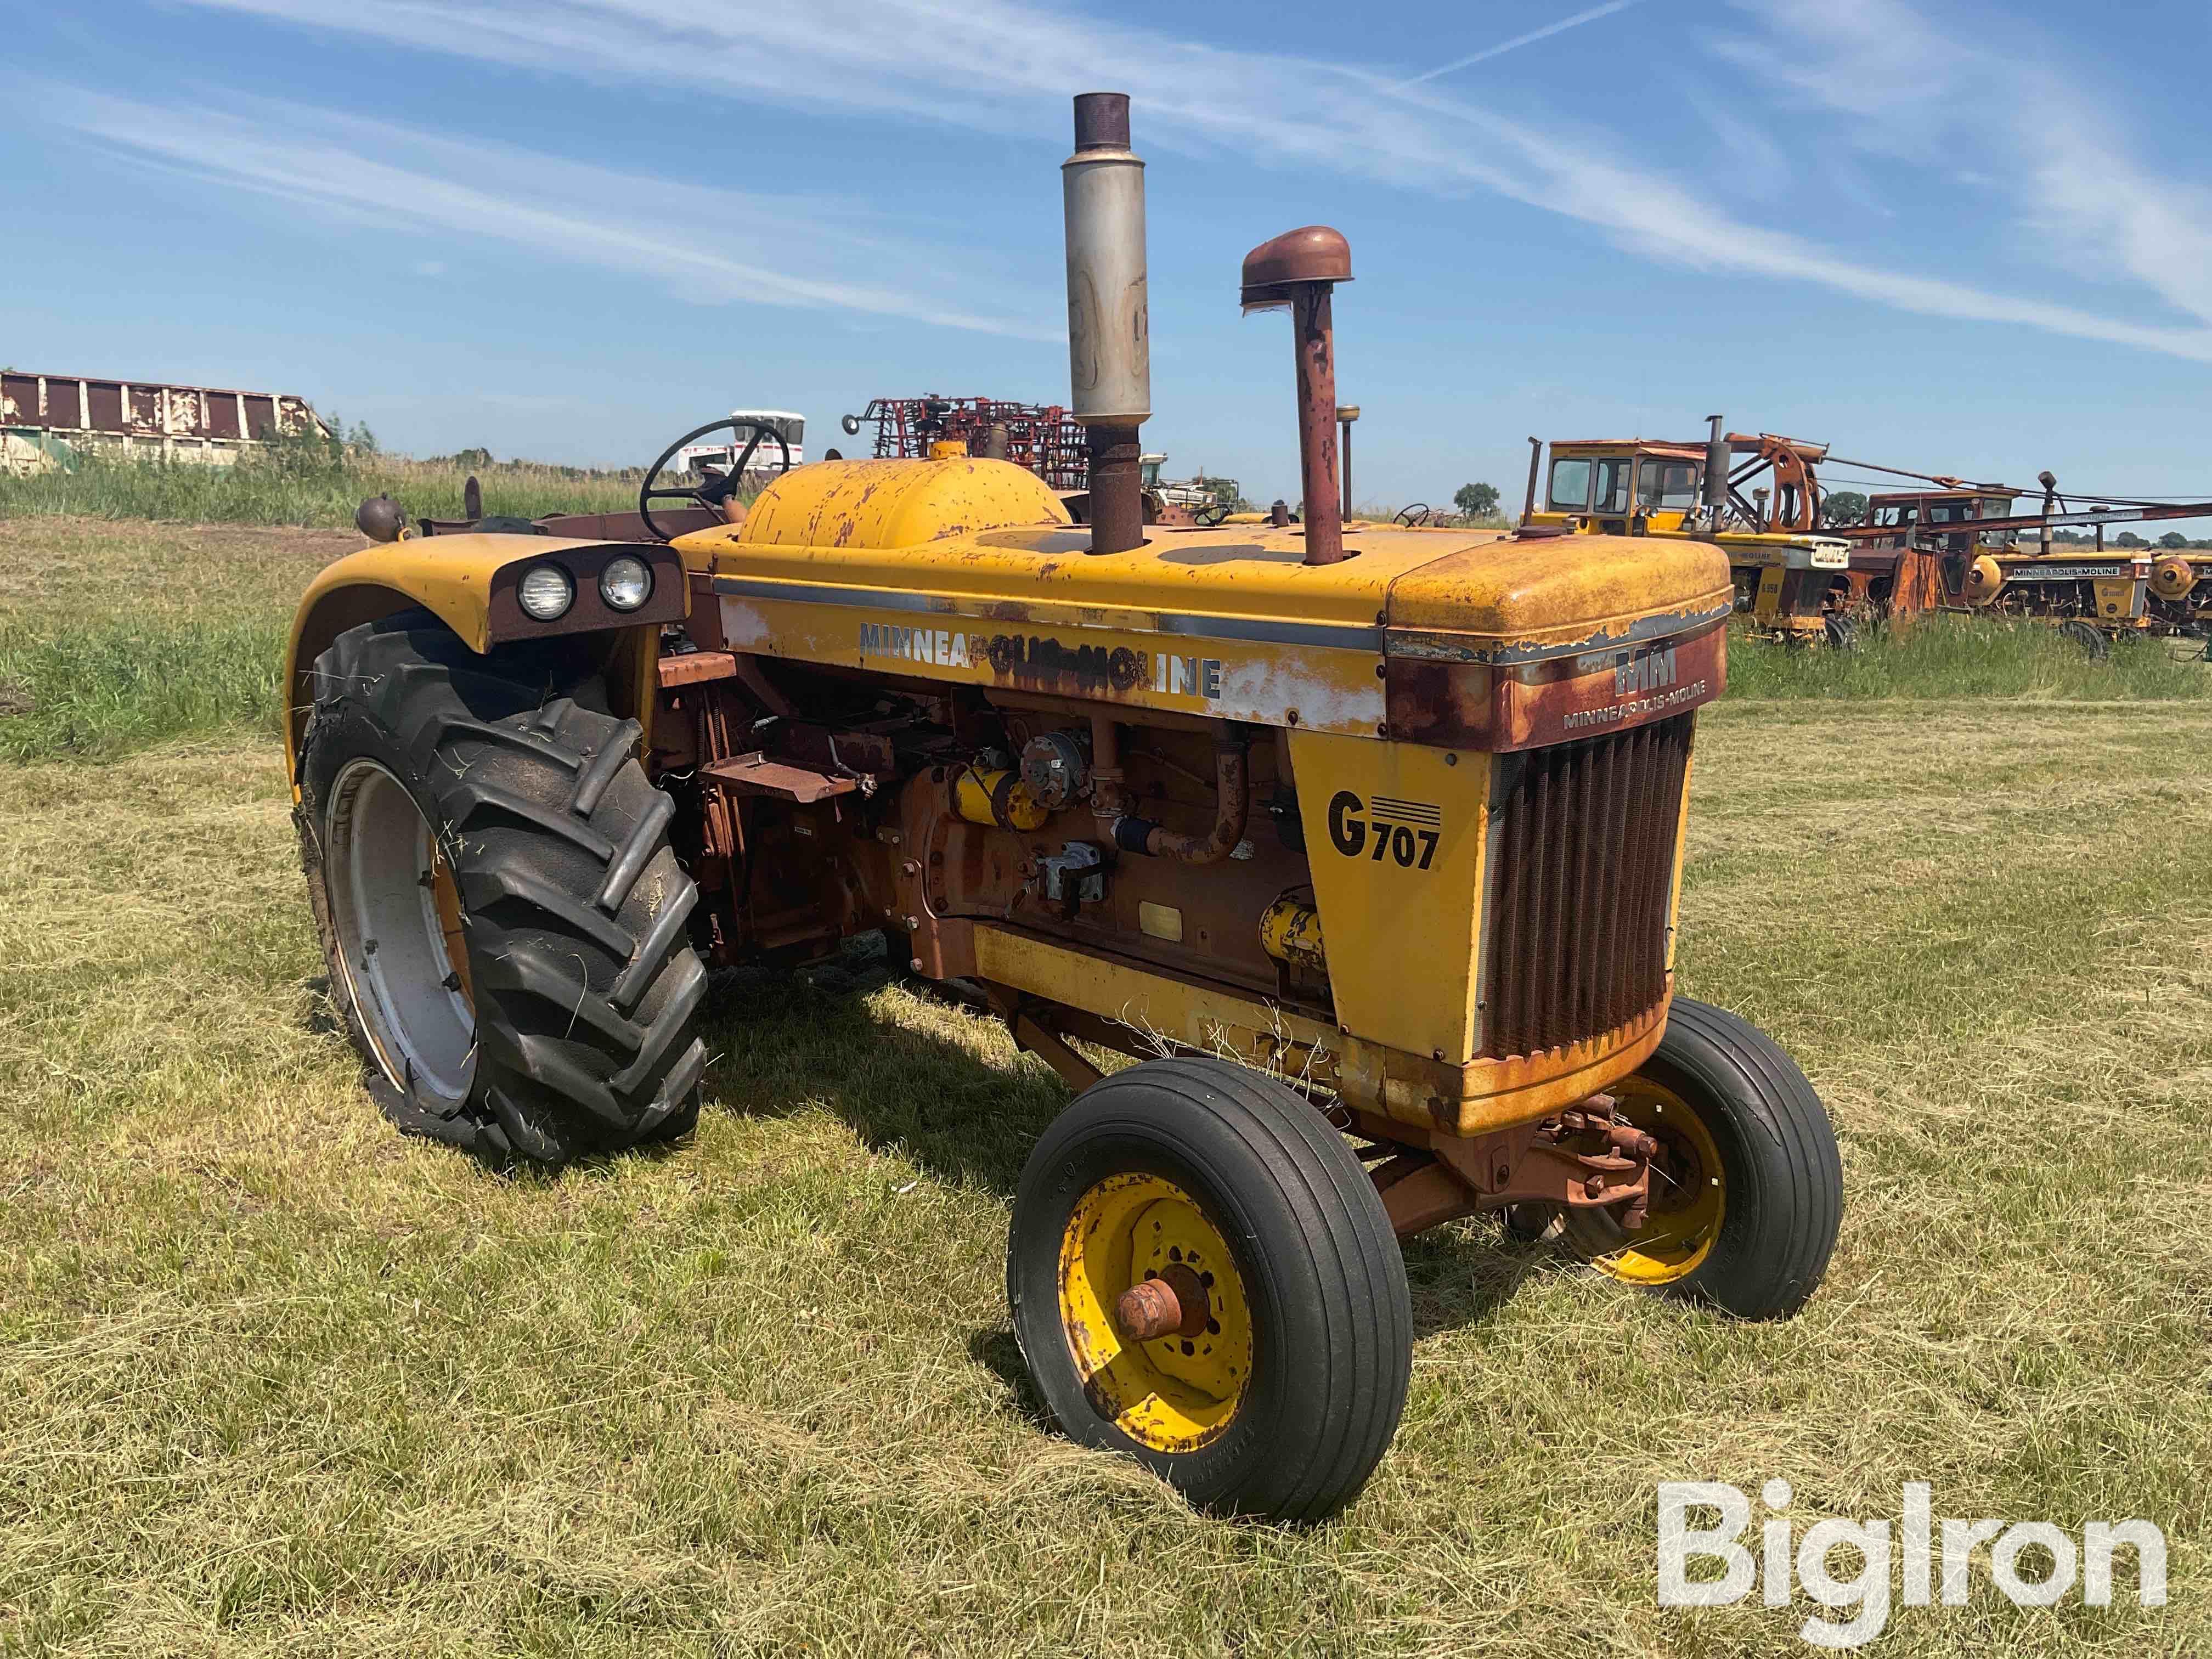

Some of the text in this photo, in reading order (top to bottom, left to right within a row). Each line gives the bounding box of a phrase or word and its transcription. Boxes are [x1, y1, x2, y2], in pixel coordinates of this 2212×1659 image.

[2015, 567, 2118, 576] MINNEAPOLIS-MOLINE
[1615, 643, 1677, 697] MM
[1564, 680, 1705, 729] MINNEAPOLIS-MOLINE
